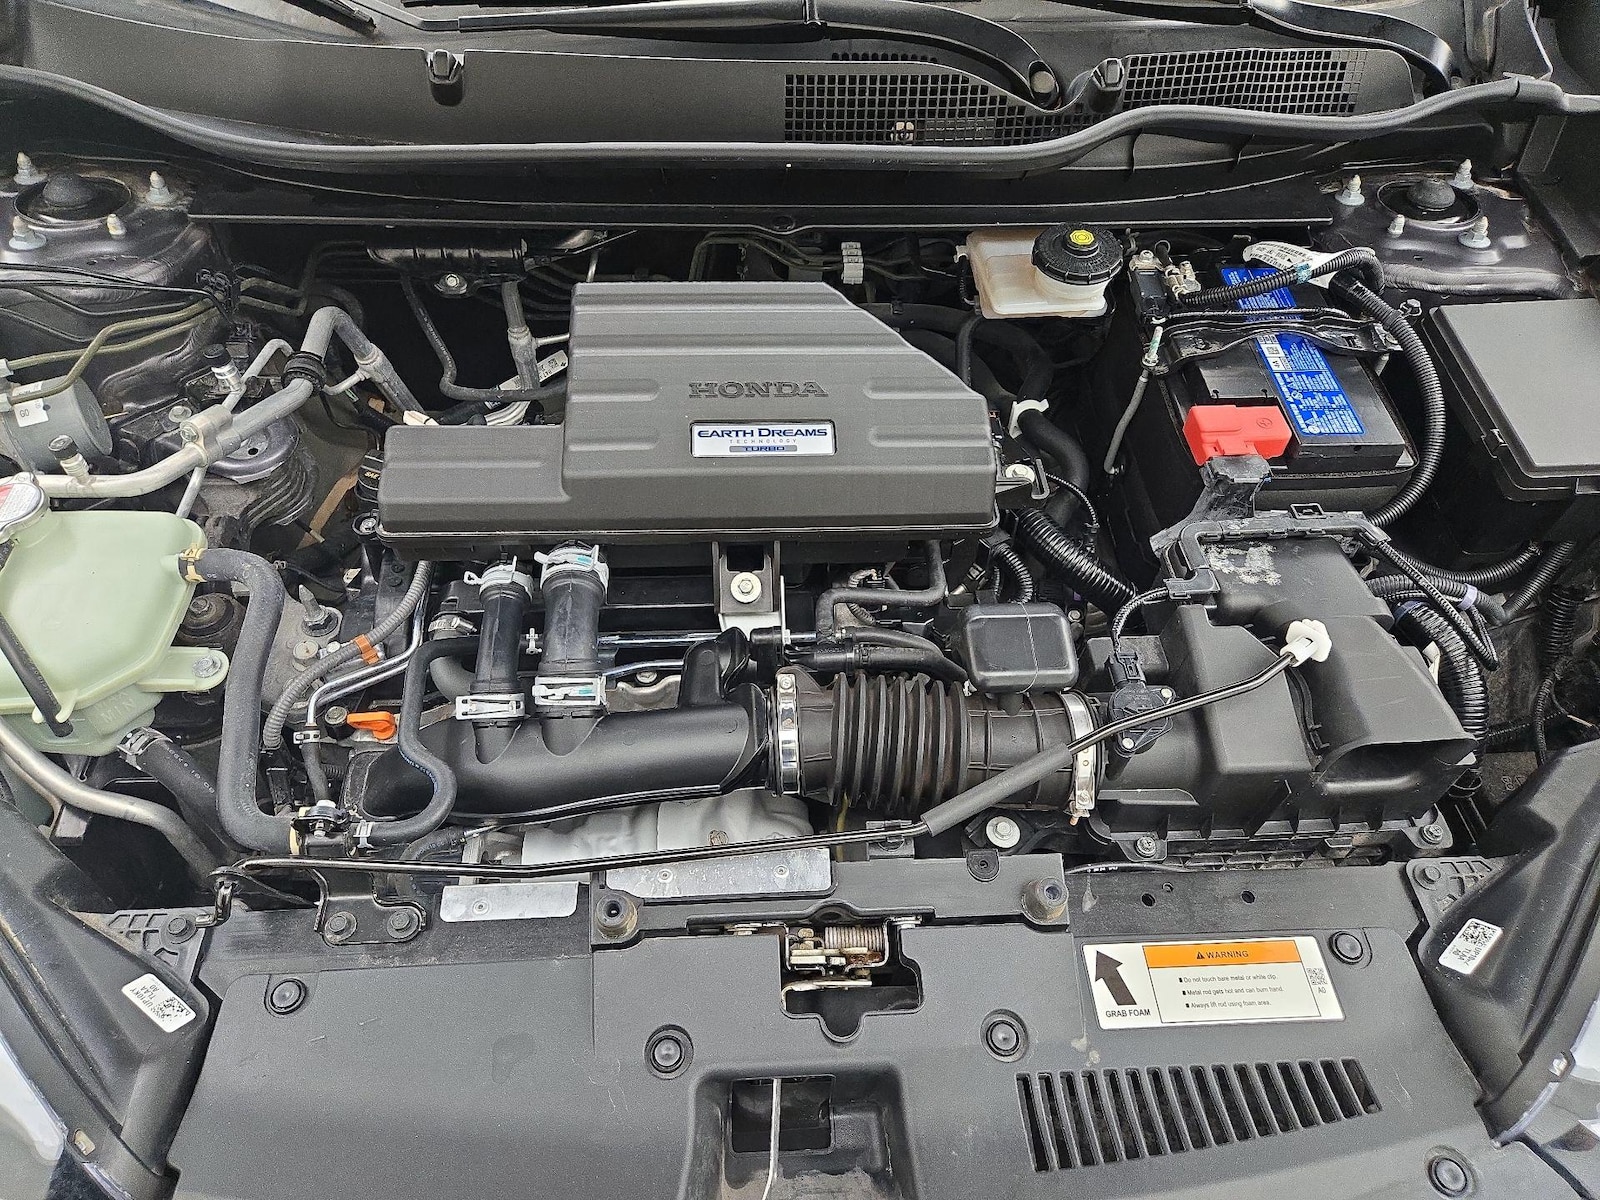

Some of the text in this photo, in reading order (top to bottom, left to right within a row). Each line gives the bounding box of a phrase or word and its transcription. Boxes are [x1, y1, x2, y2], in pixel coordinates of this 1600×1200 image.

[689, 381, 829, 398] HONDA
[697, 428, 828, 438] EARTH DREAMS
[1206, 950, 1249, 959] WARNING
[1106, 1008, 1151, 1018] GRAB FOAM
